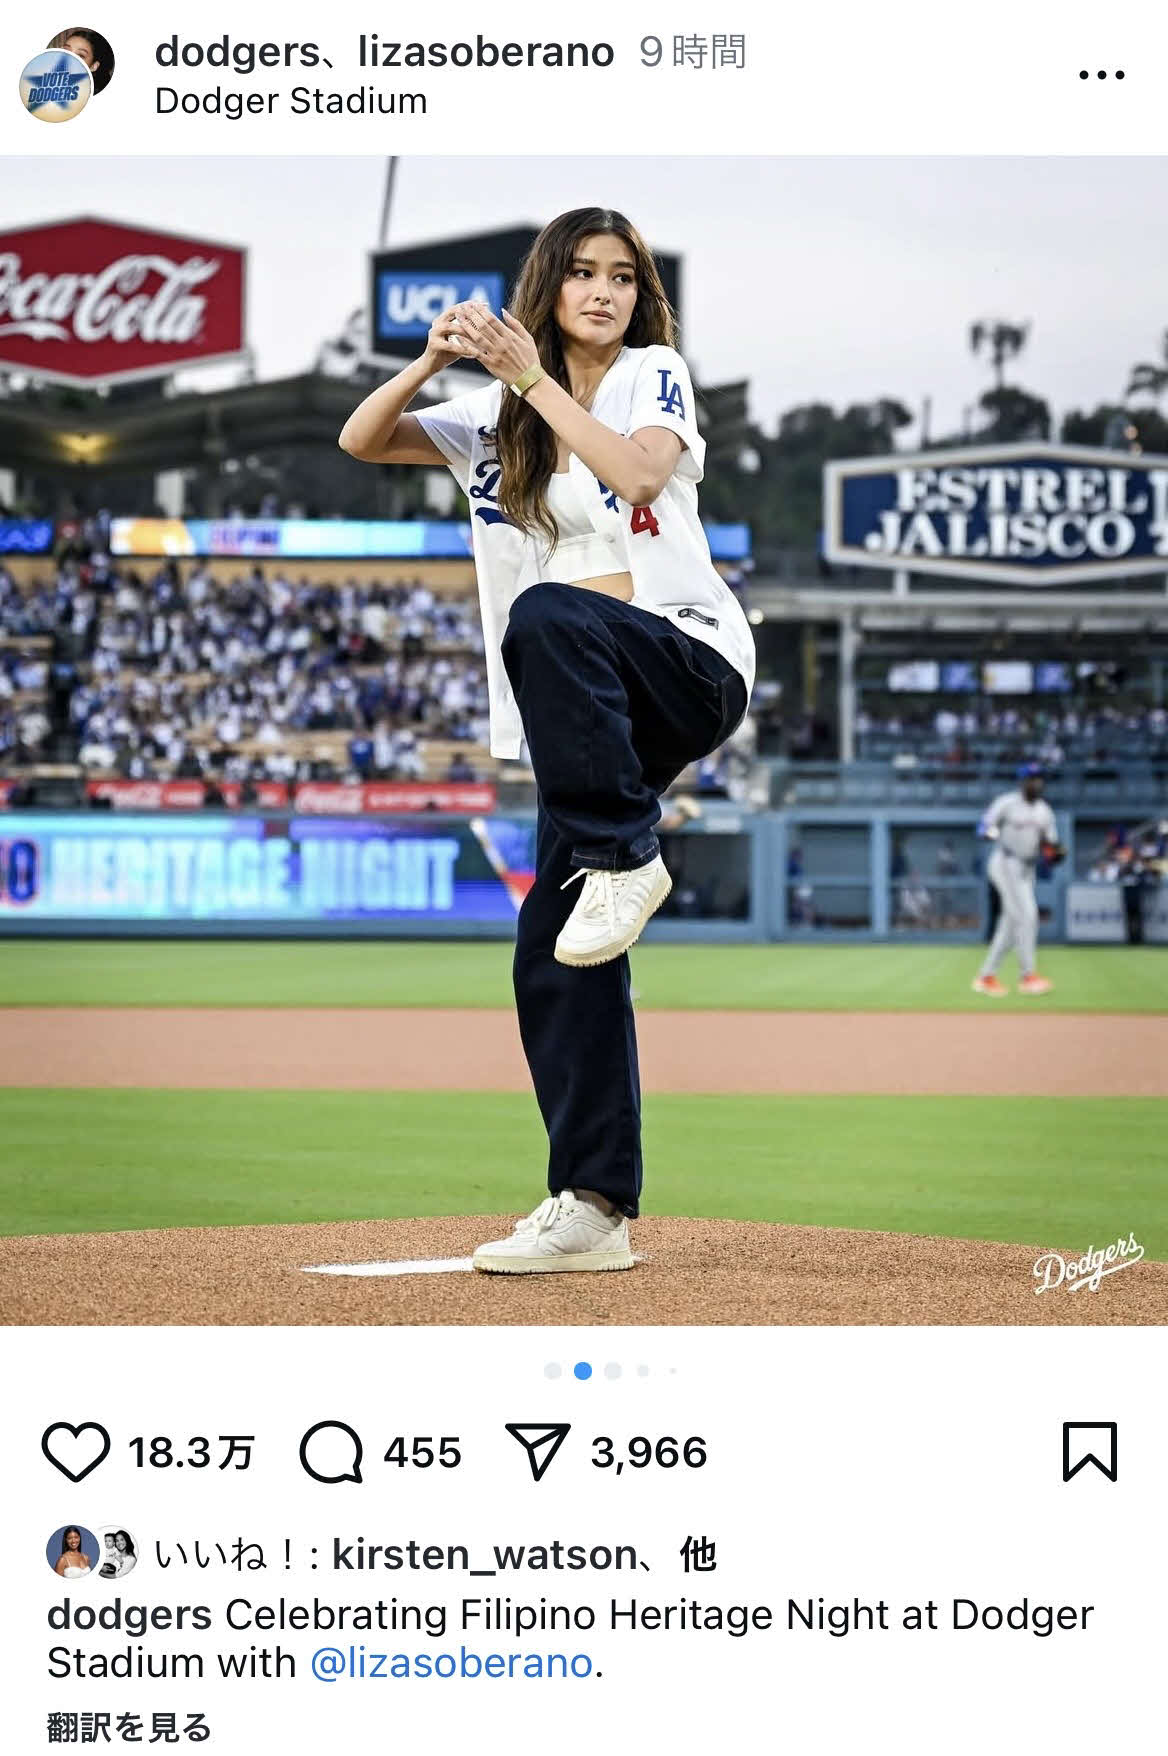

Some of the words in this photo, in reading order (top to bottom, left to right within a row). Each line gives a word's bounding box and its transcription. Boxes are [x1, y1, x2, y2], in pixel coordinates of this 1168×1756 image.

[0, 252, 220, 343] ca-Cola
[656, 368, 686, 422] LA
[630, 505, 661, 538] 4
[864, 510, 1136, 558] JALISCO
[50, 837, 291, 909] HERITAGE
[301, 837, 459, 911] NIGHT
